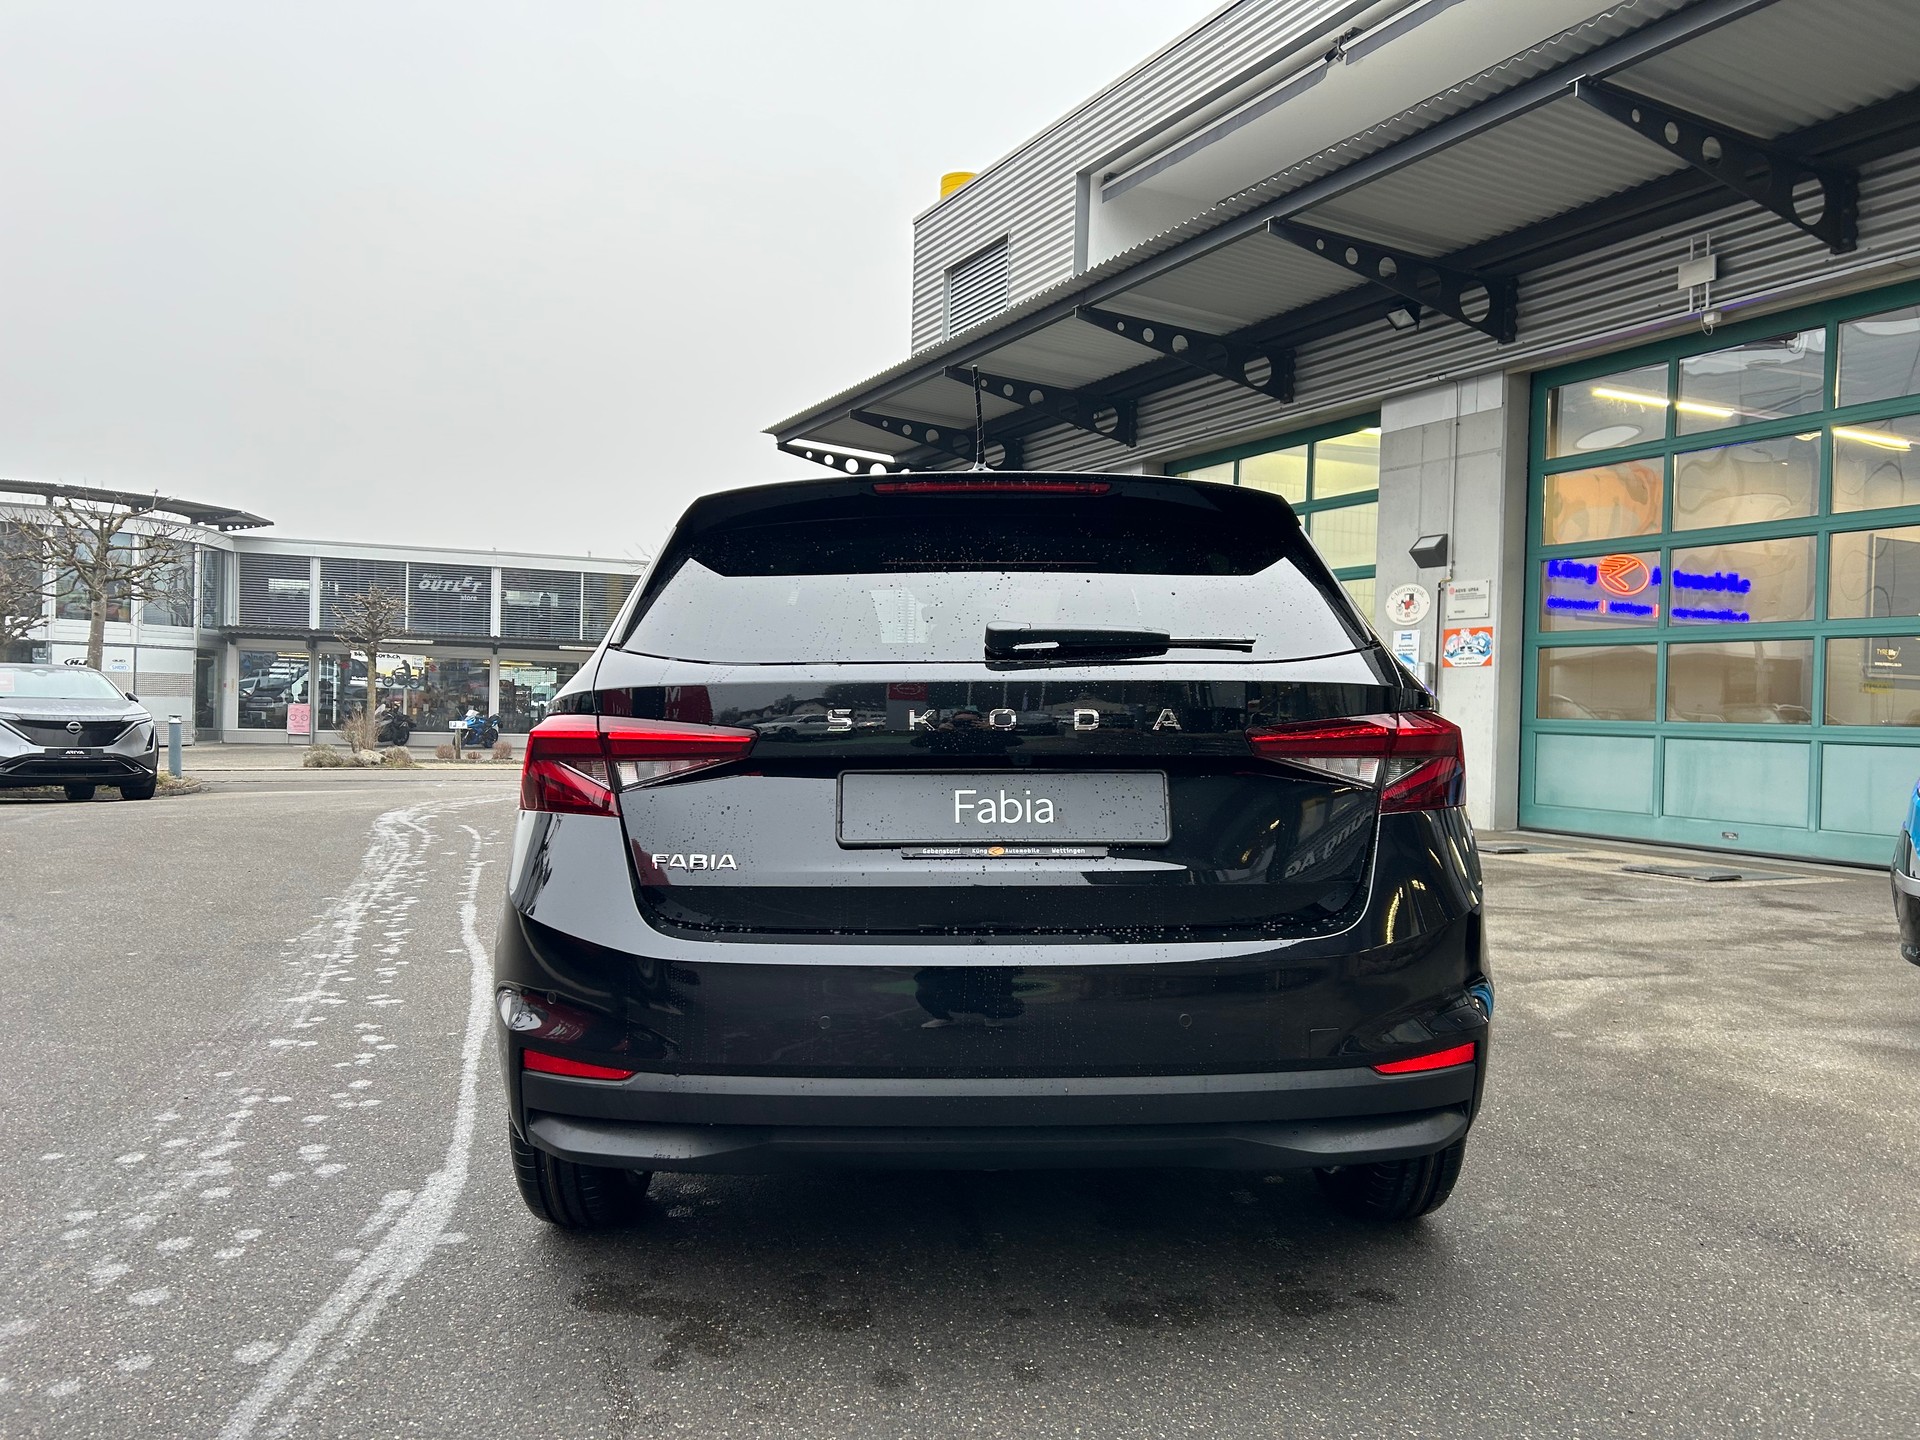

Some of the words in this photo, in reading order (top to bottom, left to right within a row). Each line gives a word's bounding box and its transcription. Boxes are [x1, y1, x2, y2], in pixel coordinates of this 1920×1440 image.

[418, 576, 482, 593] OUTLET
[954, 789, 1055, 824] Fabia
[971, 847, 988, 855] Küng
[1004, 847, 1040, 855] Automobile
[1051, 847, 1086, 855] Wettingen
[651, 853, 738, 871] FABIA
